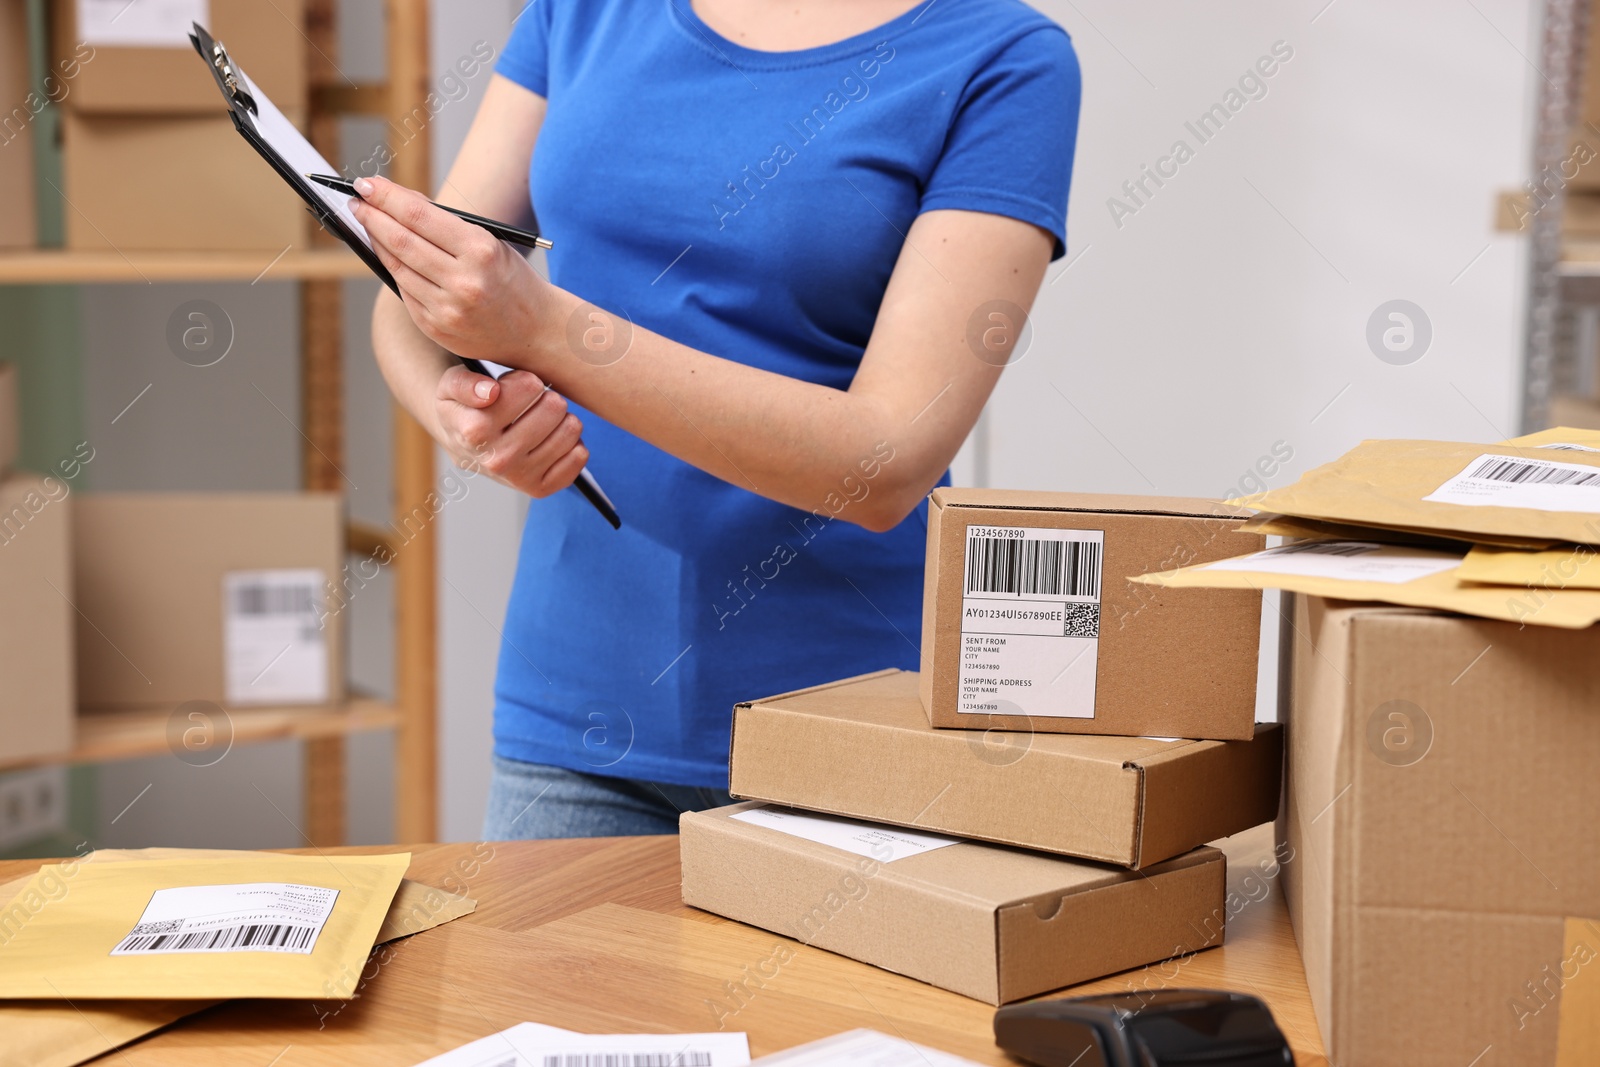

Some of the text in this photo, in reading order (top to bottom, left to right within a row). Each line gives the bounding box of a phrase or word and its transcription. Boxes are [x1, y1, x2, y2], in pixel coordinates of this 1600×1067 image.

[970, 528, 1025, 538] 1234567890
[966, 608, 1062, 621] AY01234UI567890EE
[964, 678, 1032, 687] SHIPPING ADDRESS
